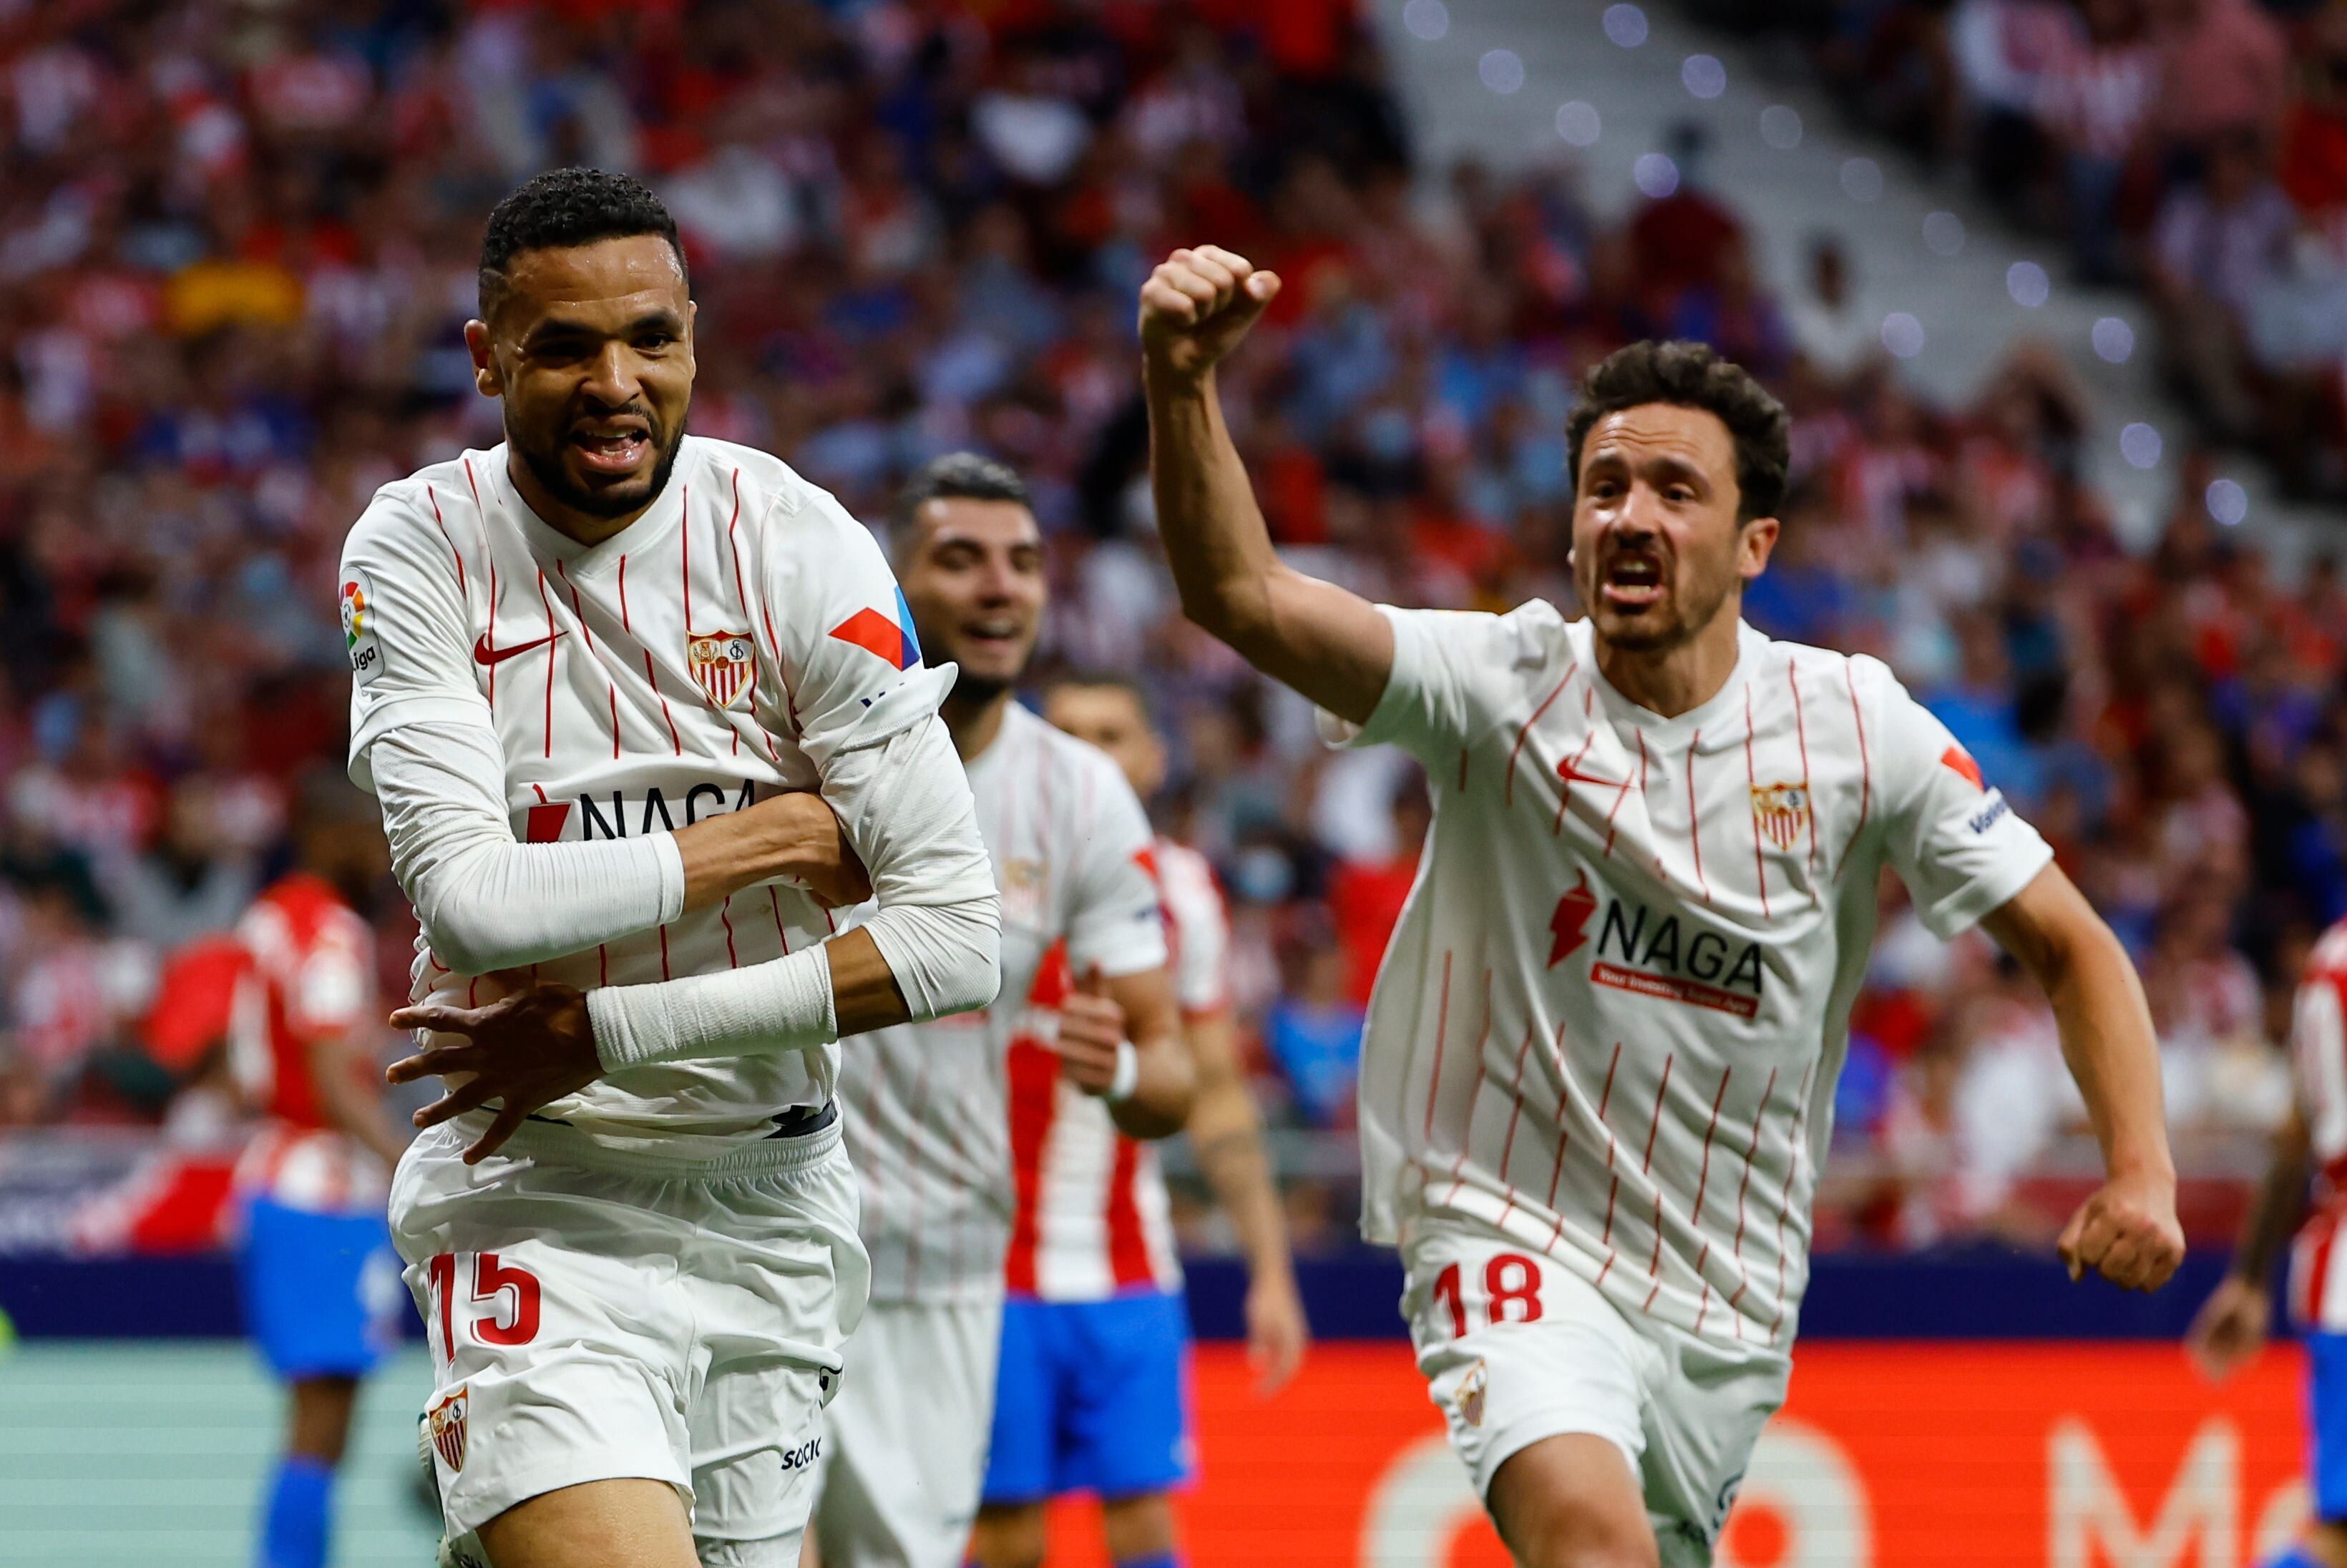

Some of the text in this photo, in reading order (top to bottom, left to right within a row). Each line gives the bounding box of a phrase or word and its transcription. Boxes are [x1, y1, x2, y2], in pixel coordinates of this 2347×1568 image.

[353, 646, 376, 671] iga
[1598, 898, 1762, 994] NAGA
[427, 1252, 541, 1368] 15
[1433, 1253, 1543, 1340] 18
